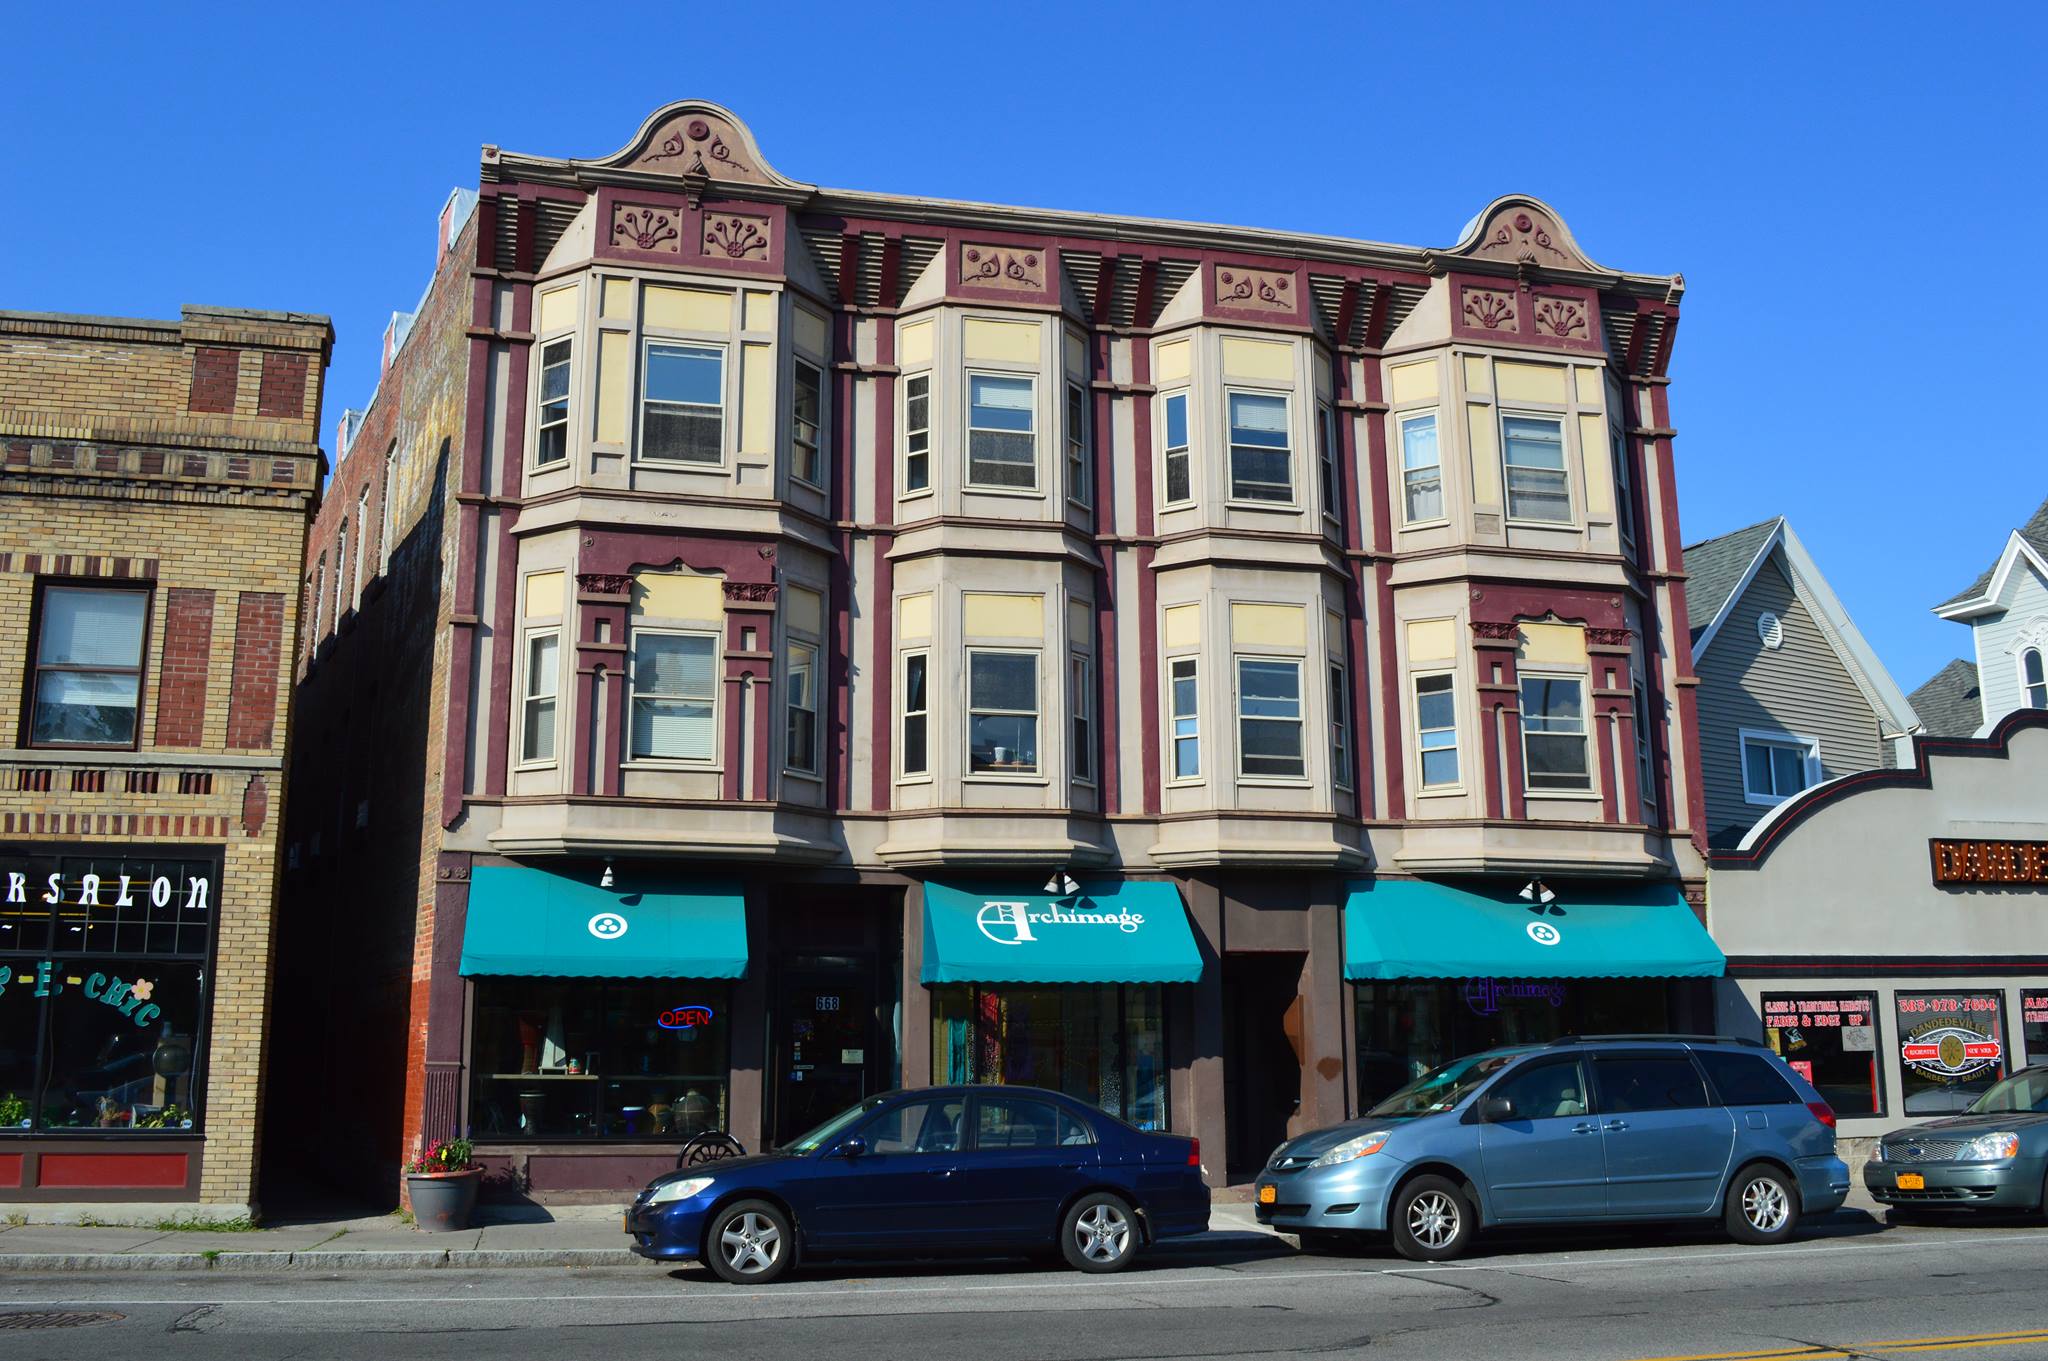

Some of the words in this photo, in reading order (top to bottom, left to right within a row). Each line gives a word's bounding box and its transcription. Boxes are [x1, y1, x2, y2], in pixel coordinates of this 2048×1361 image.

[976, 901, 1145, 945] Archimage
[817, 997, 840, 1010] 668
[660, 1011, 709, 1026] OPEN
[1766, 1015, 1799, 1028] FADES
[1801, 1014, 1812, 1027] &
[1814, 1014, 1841, 1027] EDGE
[1848, 1014, 1864, 1026] UP
[1915, 1067, 1947, 1083] BARBER
[1962, 1066, 1991, 1082] BEAUTY
